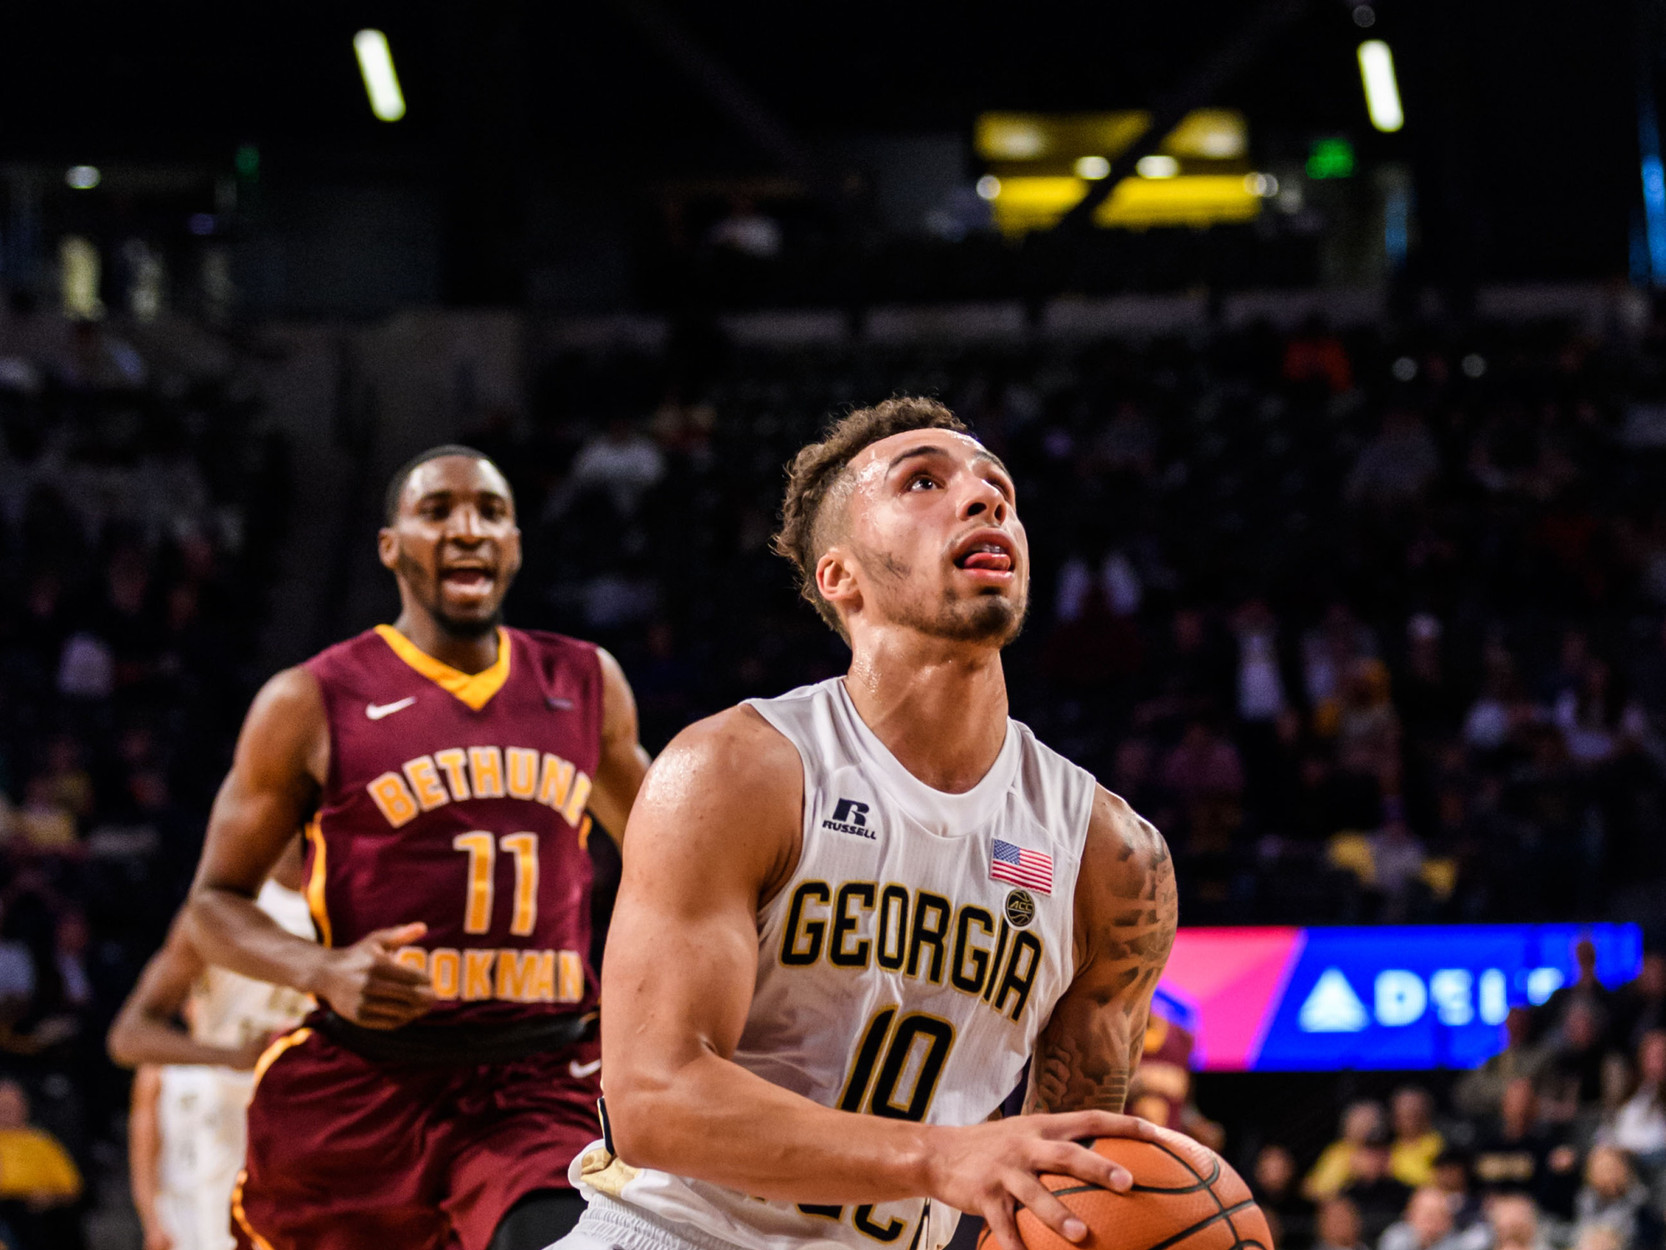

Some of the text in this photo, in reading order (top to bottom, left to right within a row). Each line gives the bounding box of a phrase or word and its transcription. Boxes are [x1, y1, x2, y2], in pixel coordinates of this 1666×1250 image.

[822, 820, 877, 840] RUSSELL
[452, 831, 538, 935] 11
[1010, 900, 1033, 912] ACC
[779, 880, 1042, 1024] GEORGIA
[836, 1003, 957, 1123] 10
